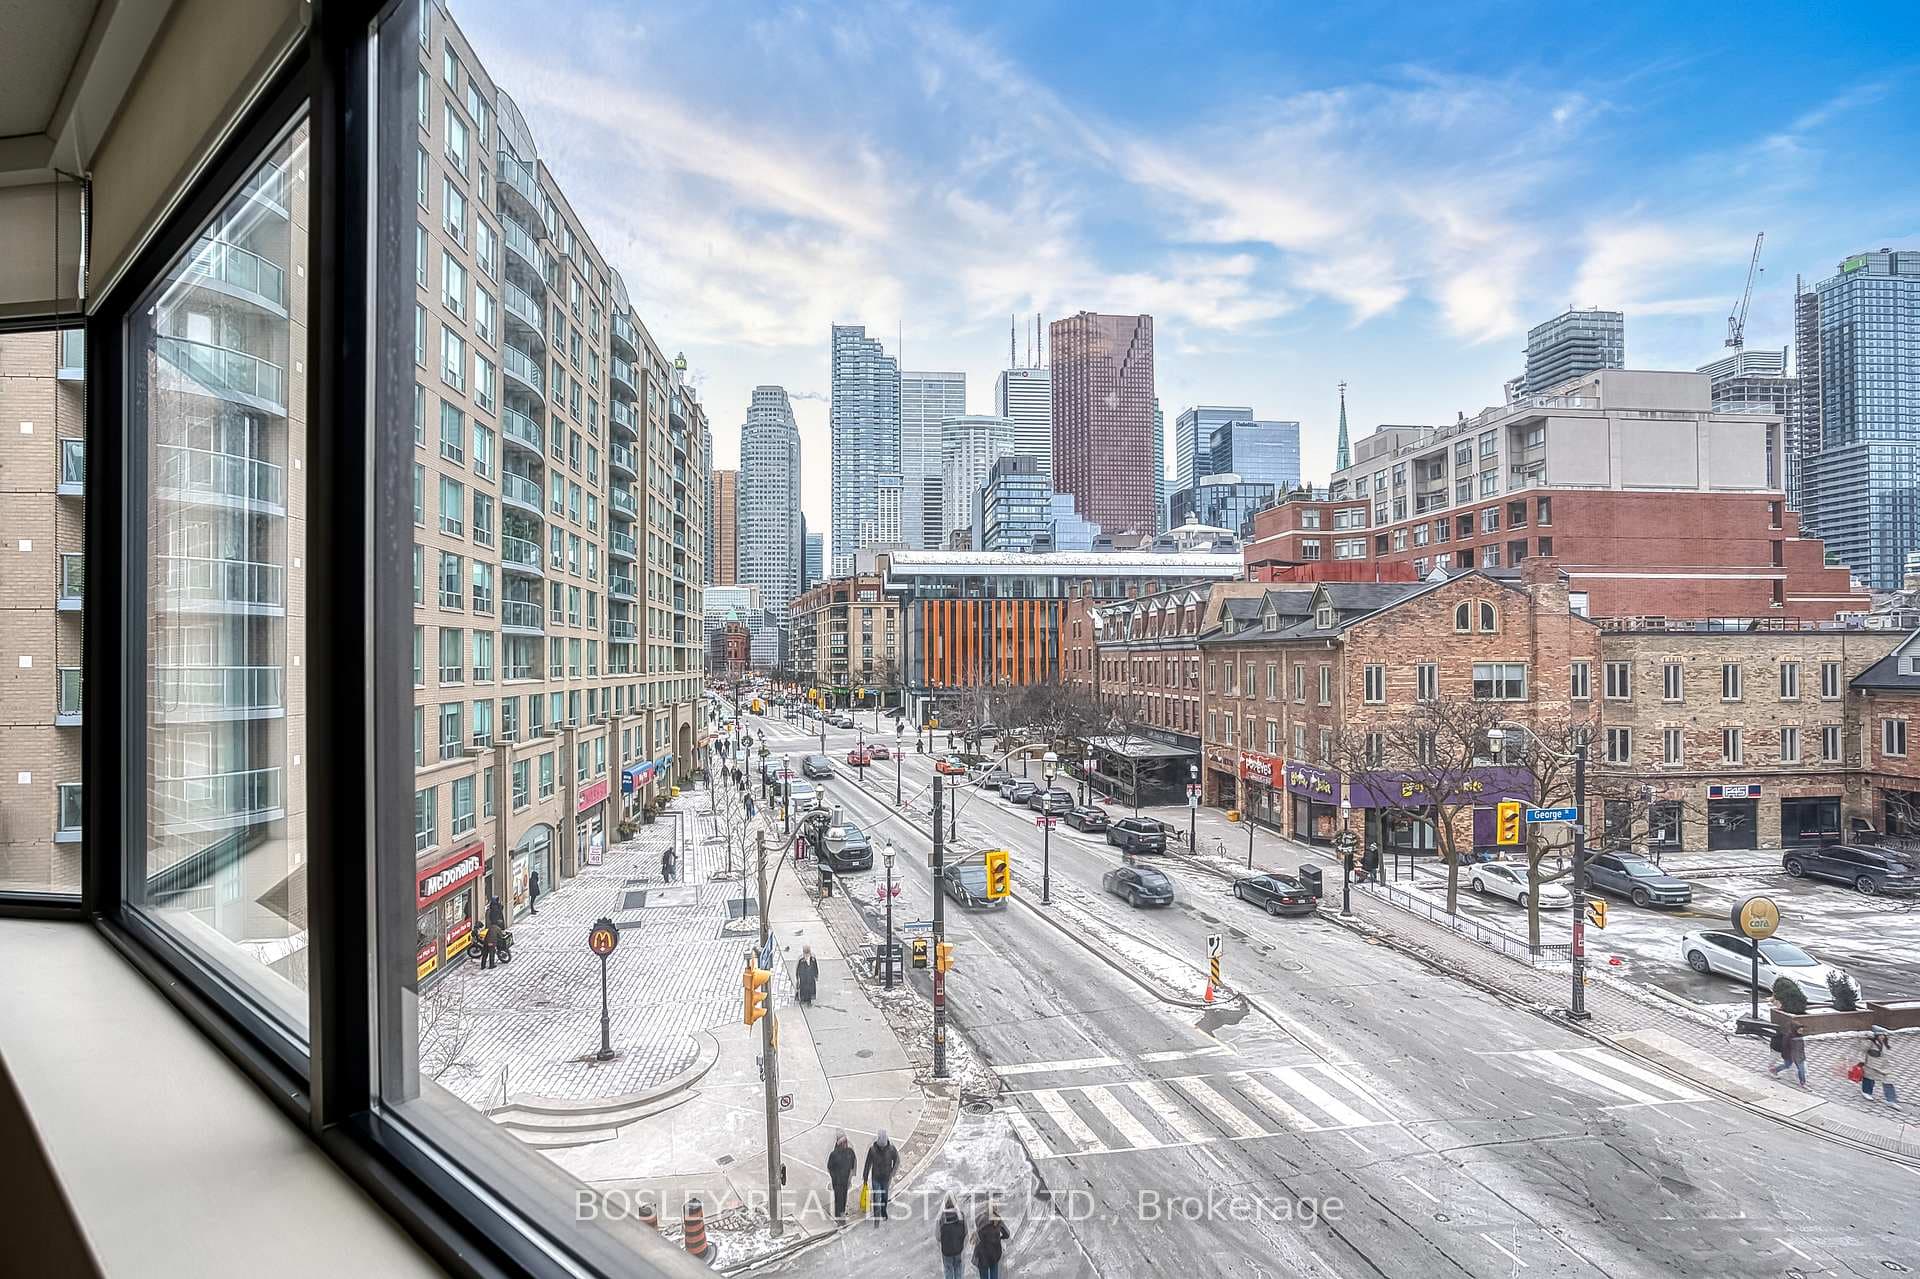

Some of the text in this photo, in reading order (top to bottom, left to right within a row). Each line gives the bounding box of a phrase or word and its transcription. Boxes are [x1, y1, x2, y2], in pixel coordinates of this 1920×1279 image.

[1725, 787, 1746, 797] F45
[1534, 810, 1562, 820] George
[424, 856, 480, 897] McDonald's
